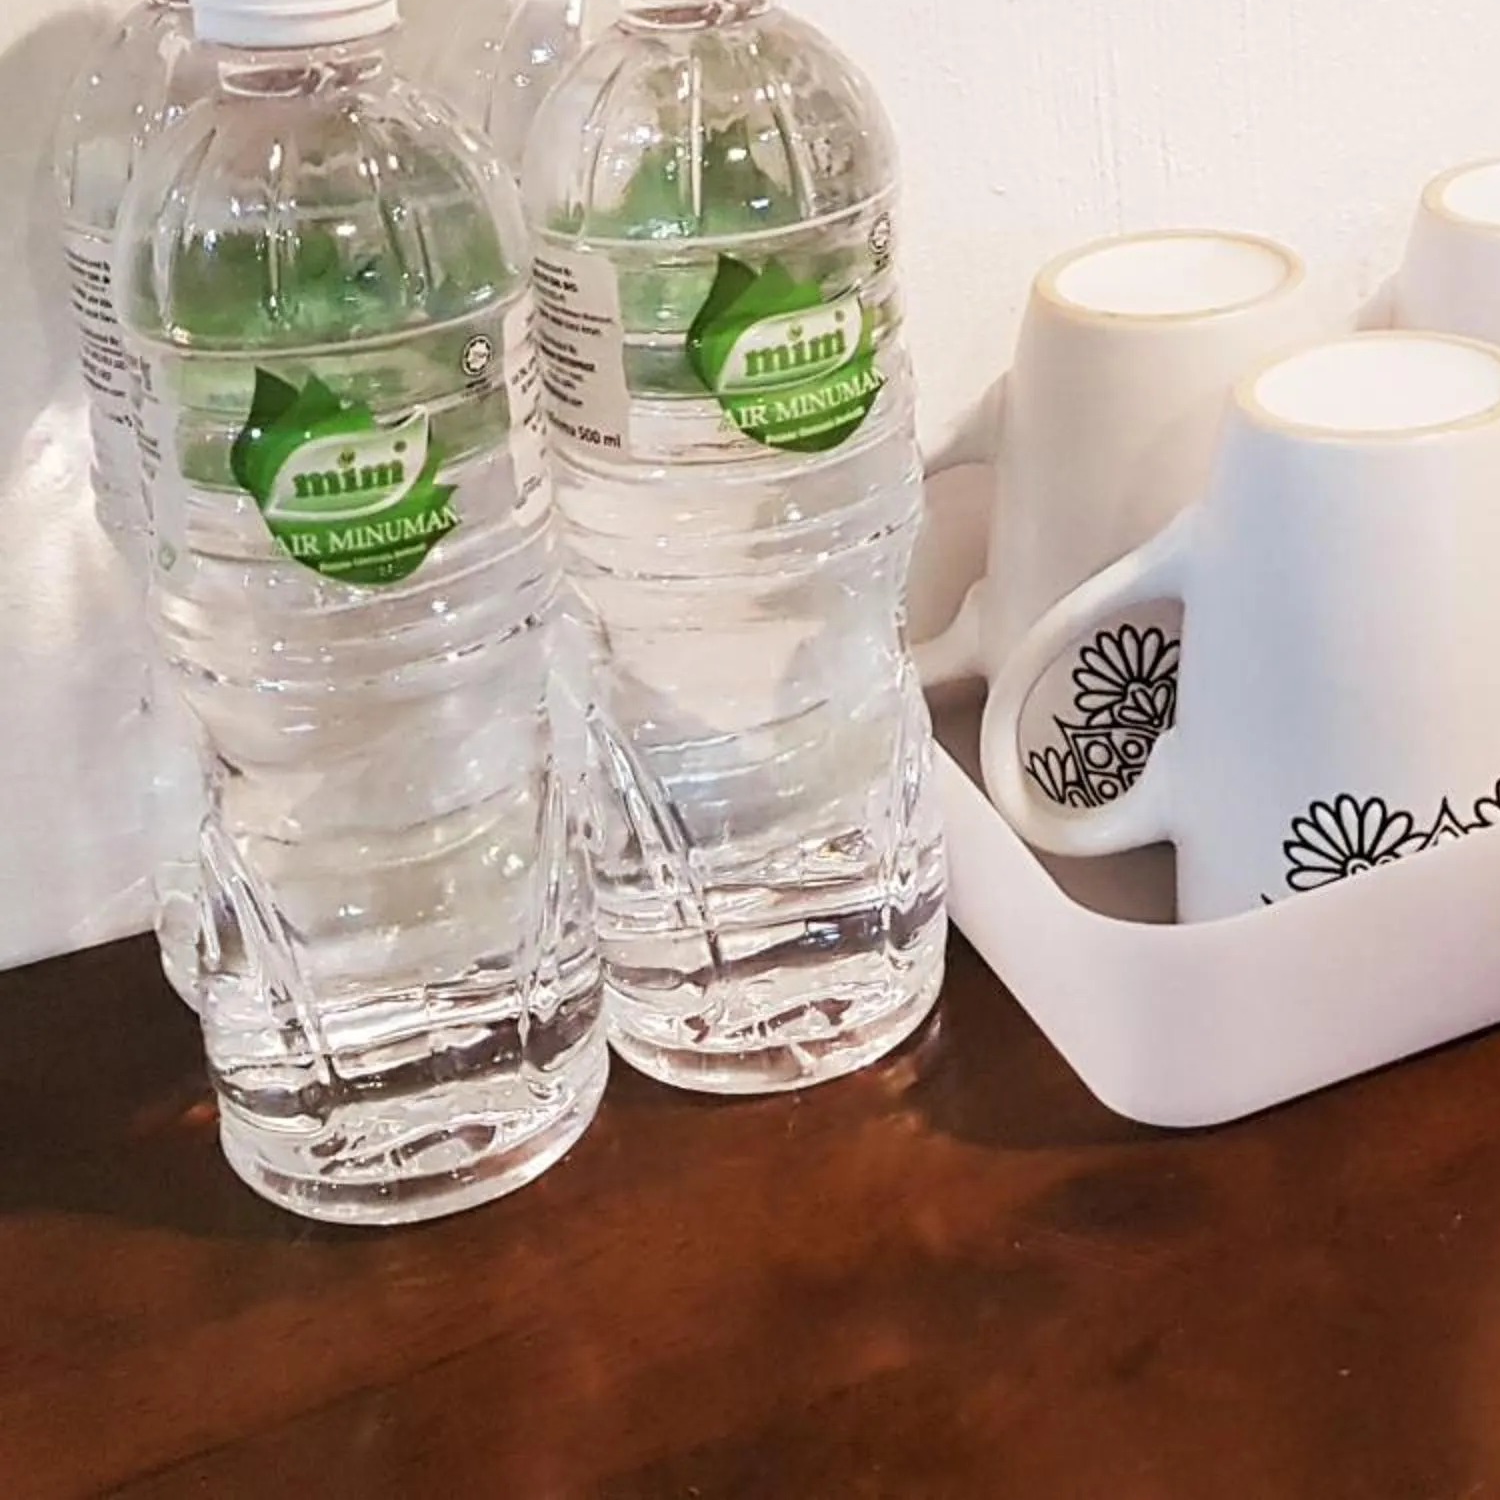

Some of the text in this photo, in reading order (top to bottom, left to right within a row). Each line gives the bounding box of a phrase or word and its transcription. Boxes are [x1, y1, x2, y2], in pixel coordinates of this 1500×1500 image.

[719, 405, 769, 431] AIR
[604, 434, 621, 448] ml
[273, 534, 321, 557] AIR
